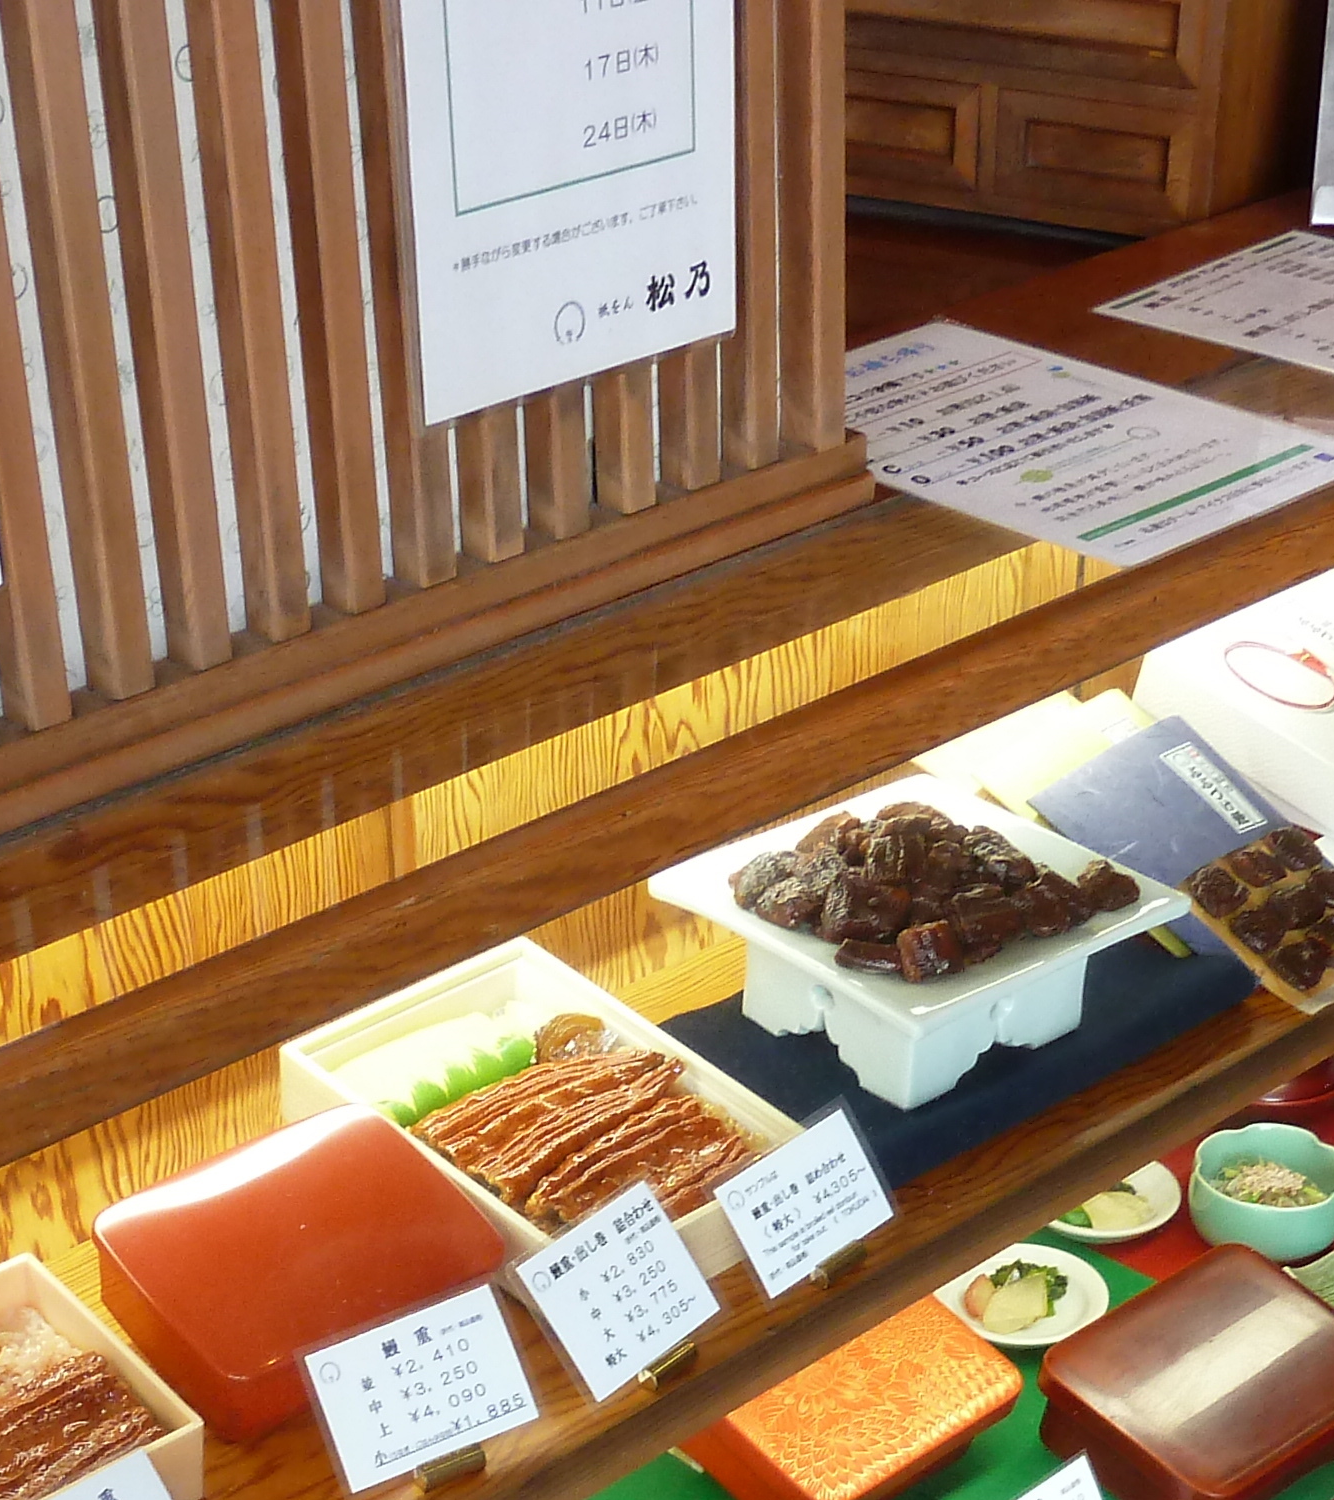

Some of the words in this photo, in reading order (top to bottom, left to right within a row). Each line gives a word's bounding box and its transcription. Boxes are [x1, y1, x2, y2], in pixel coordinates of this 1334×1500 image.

[584, 42, 660, 81] 17日(木)
[583, 107, 658, 148] 24日(木)
[646, 260, 712, 312] 松乃
[603, 1327, 616, 1343] 大
[368, 1399, 383, 1414] 中
[379, 1422, 393, 1438] 上
